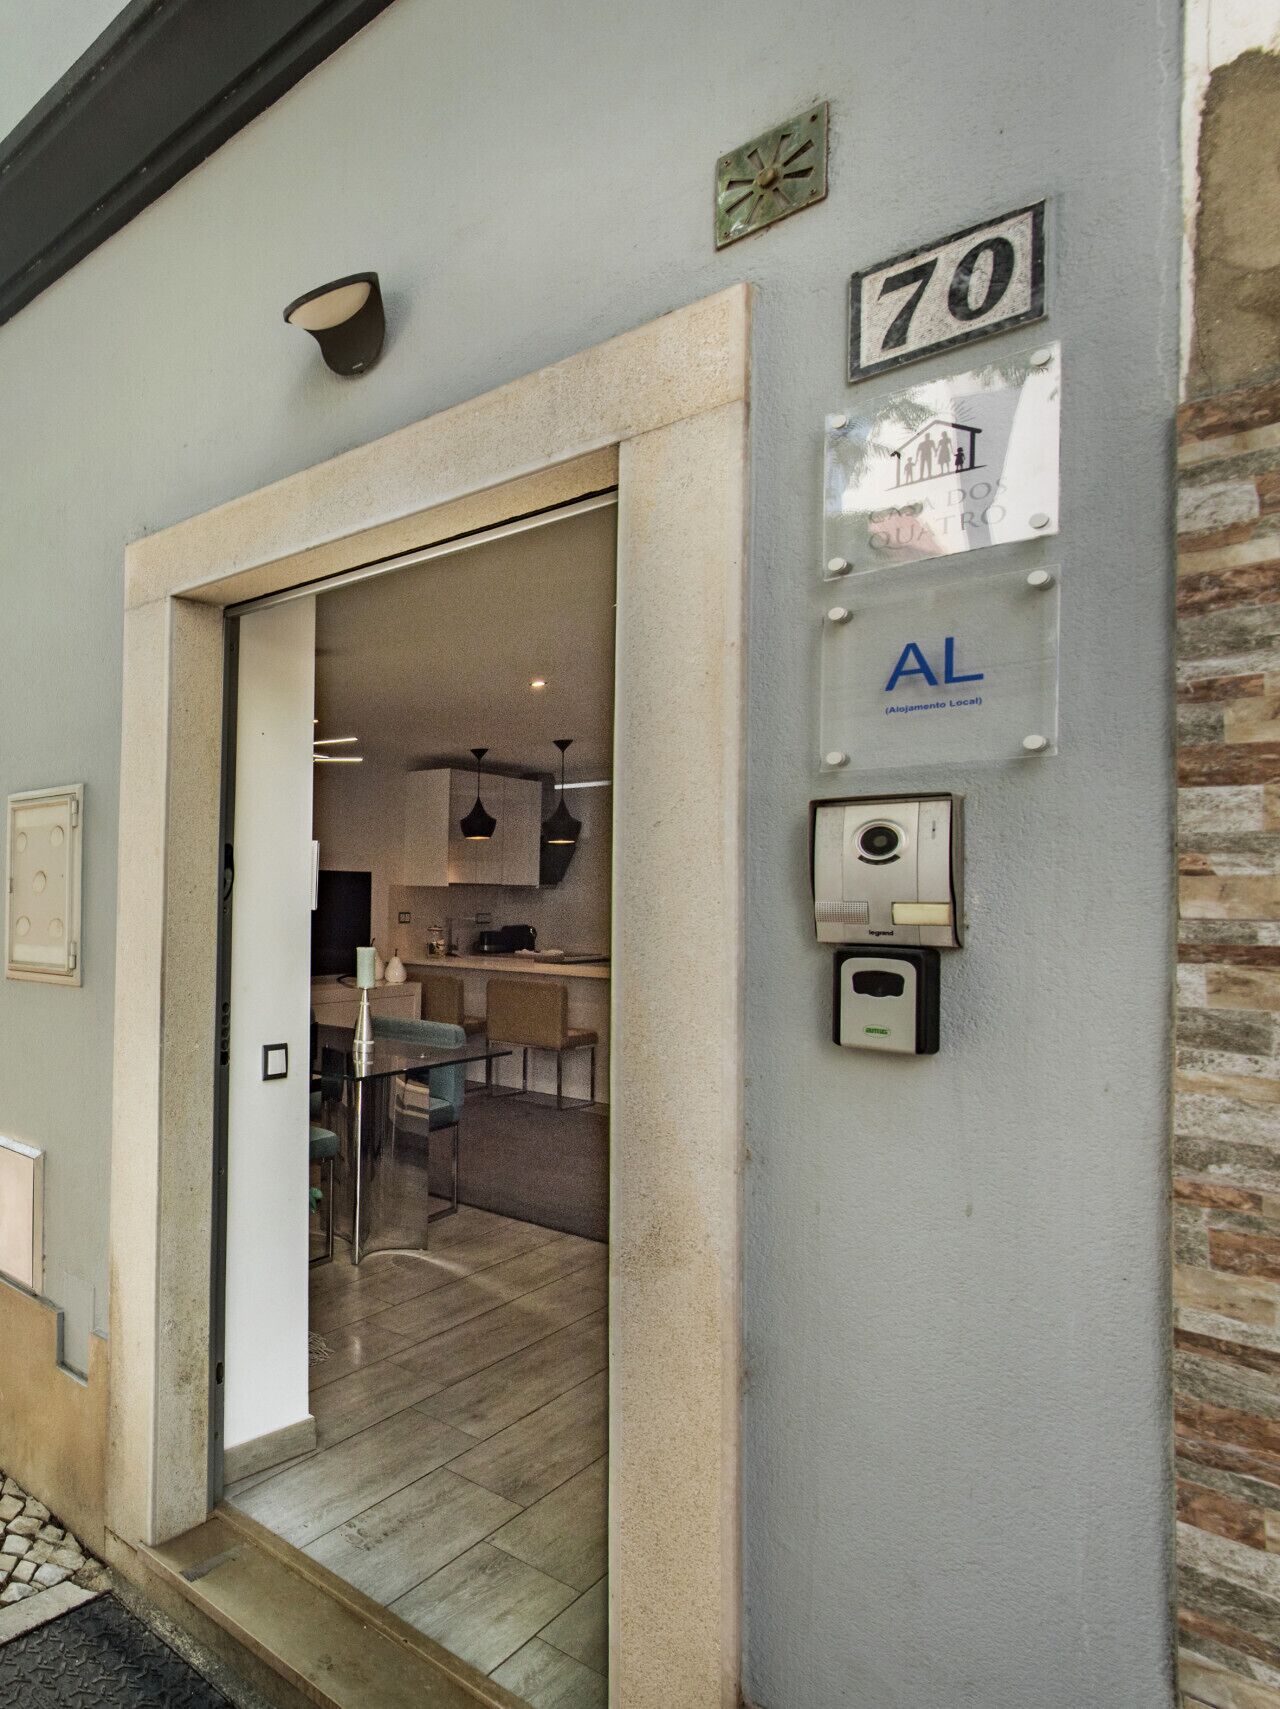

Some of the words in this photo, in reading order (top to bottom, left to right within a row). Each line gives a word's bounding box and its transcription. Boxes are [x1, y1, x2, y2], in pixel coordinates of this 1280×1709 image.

[877, 236, 1015, 351] 70
[947, 478, 1007, 507] DOS
[868, 504, 1007, 550] QUATRO
[884, 636, 984, 692] AL
[885, 701, 946, 716] (Alojamento
[949, 697, 983, 708] Local)
[868, 929, 894, 937] legrand
